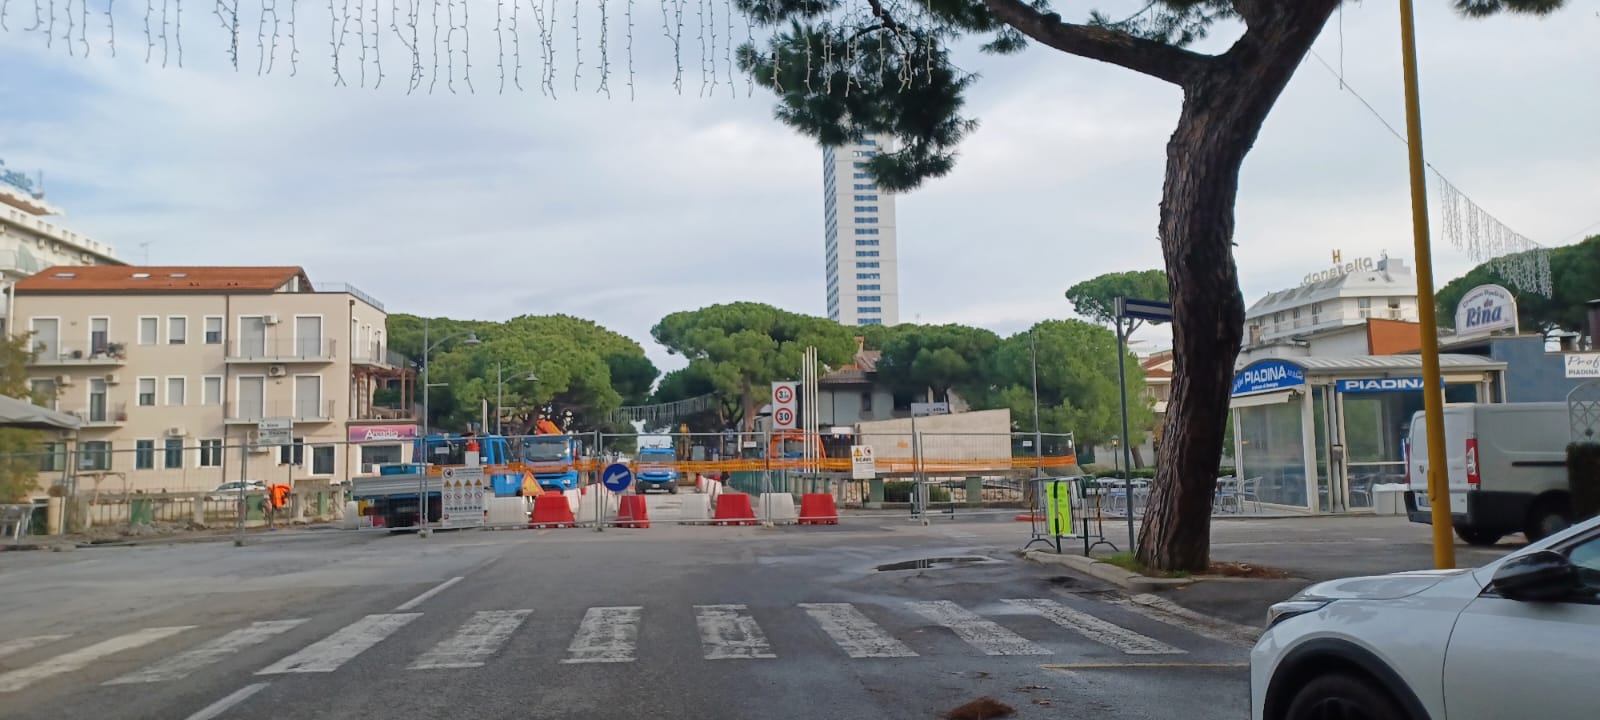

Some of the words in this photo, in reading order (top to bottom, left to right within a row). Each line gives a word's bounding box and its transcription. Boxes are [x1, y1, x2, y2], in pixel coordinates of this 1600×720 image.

[1332, 249, 1341, 264] H
[1466, 305, 1502, 328] Rina
[1244, 365, 1287, 385] PIADINA
[778, 412, 790, 421] 30
